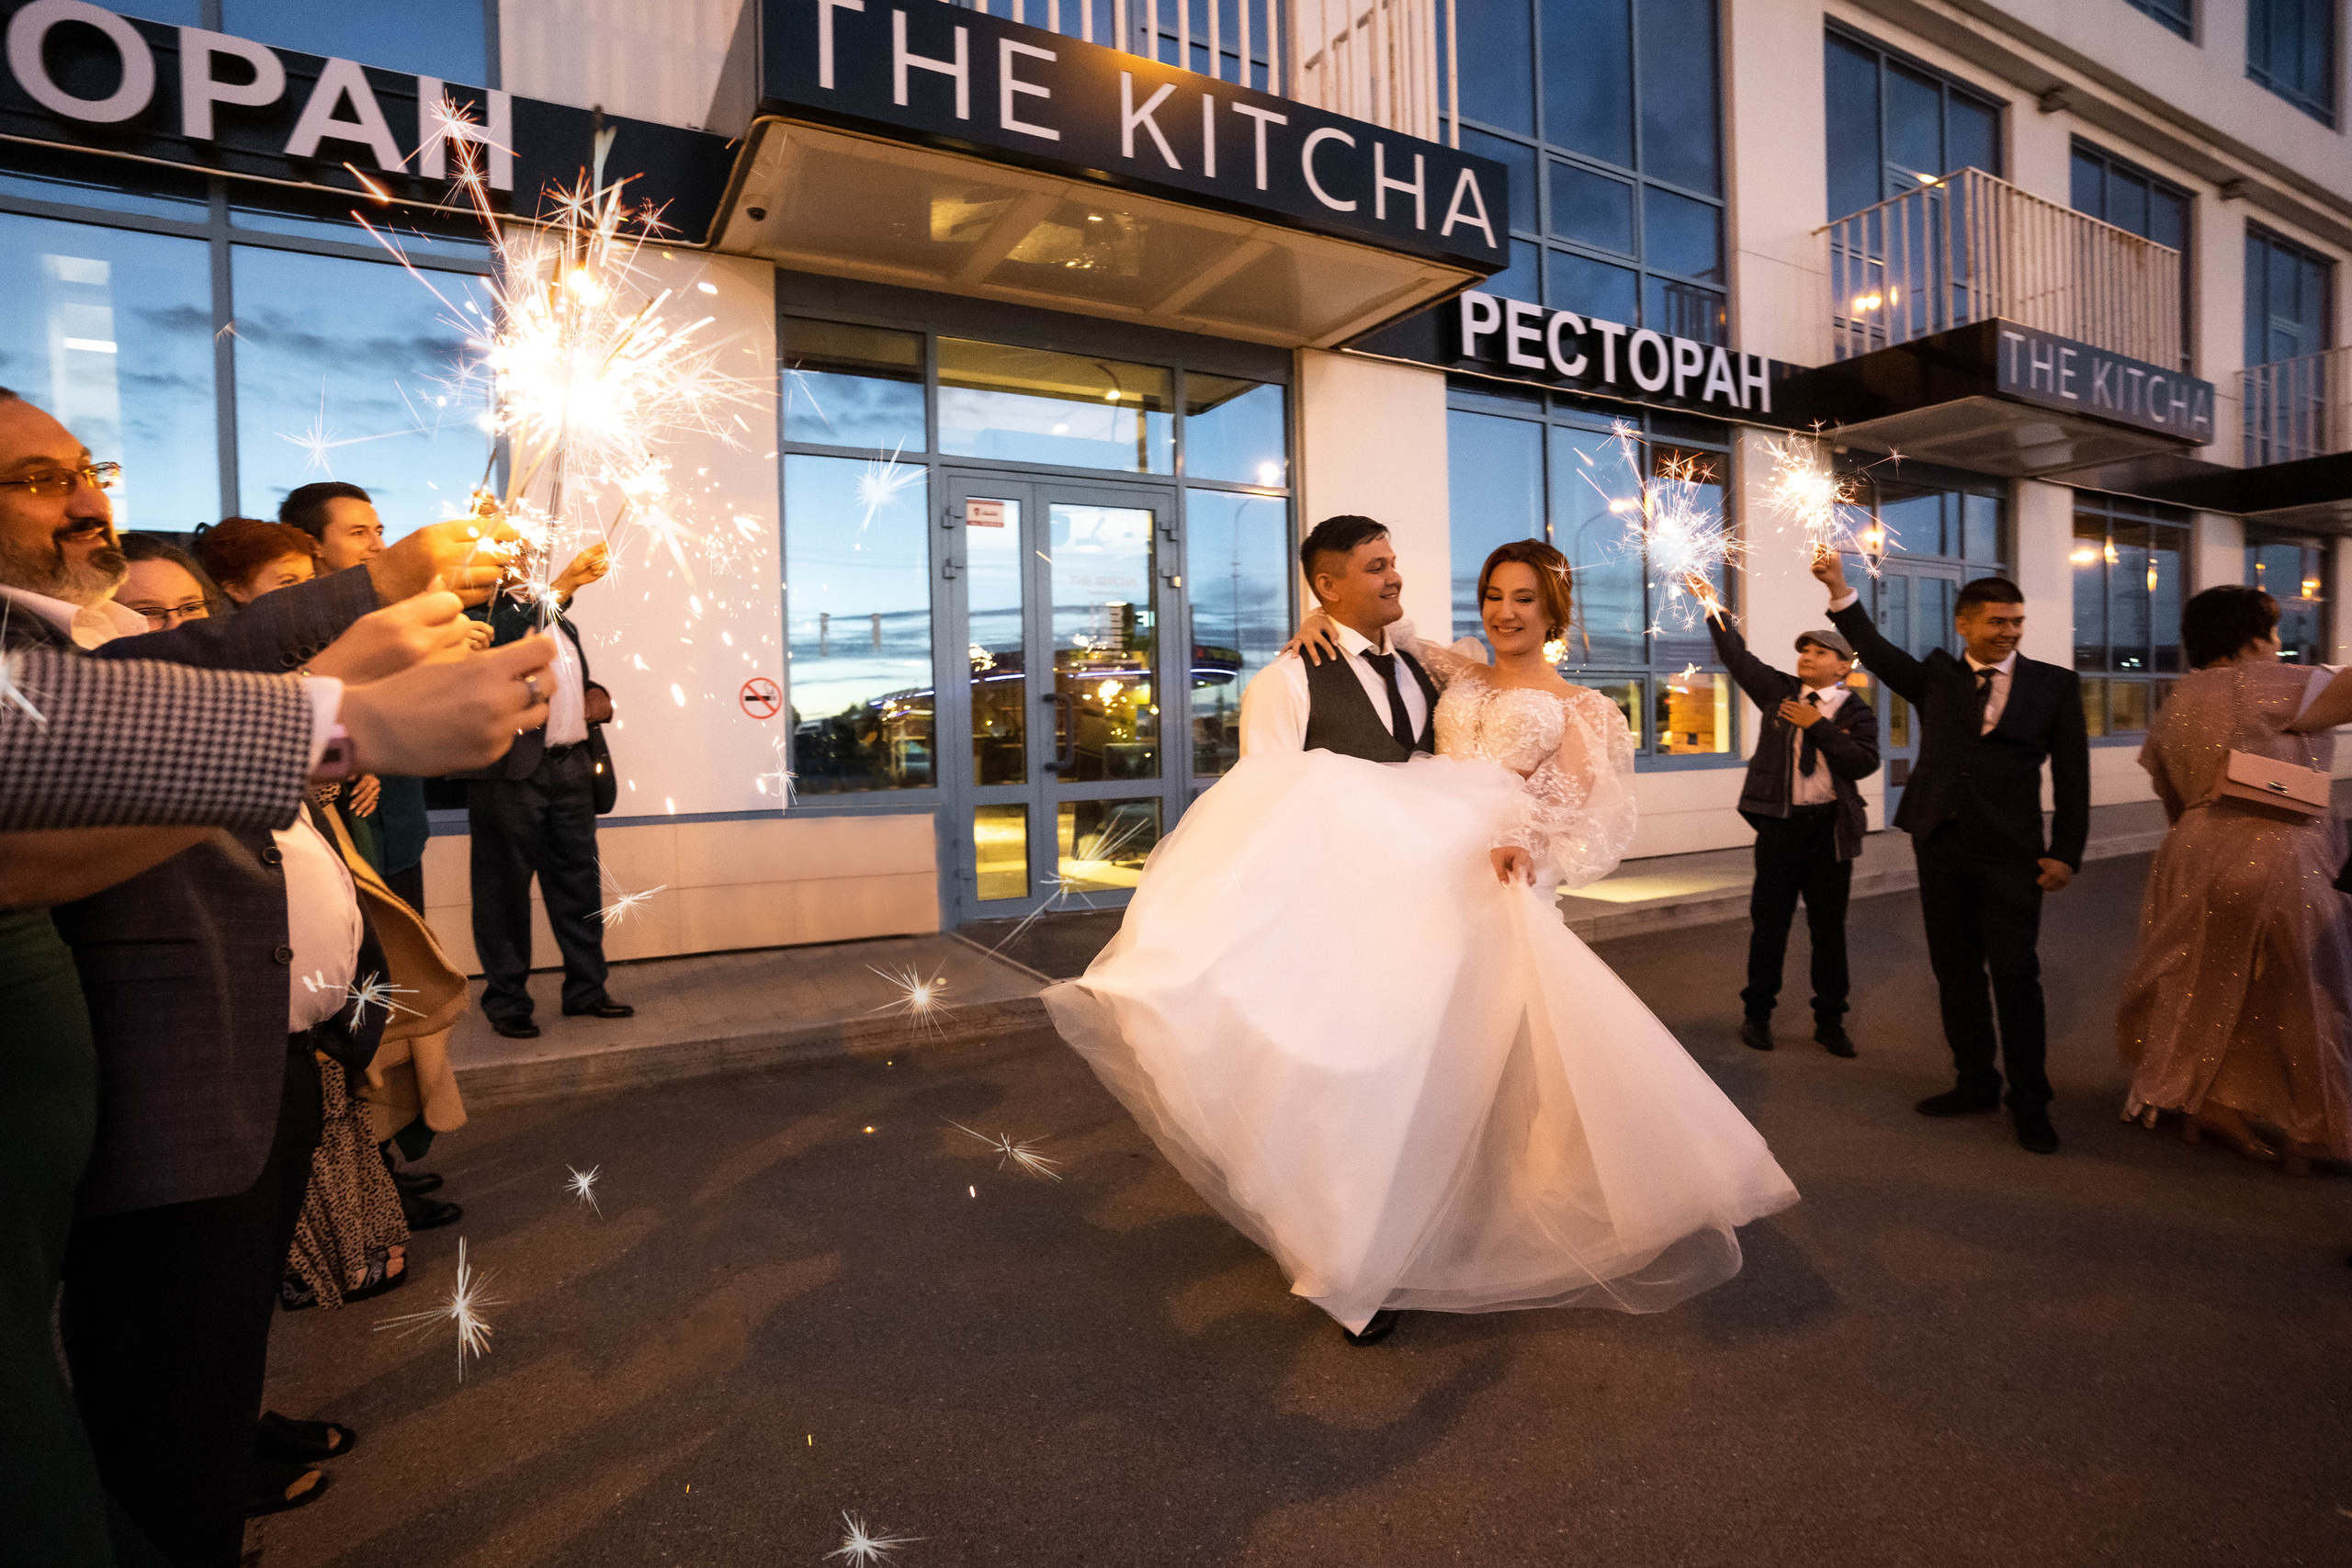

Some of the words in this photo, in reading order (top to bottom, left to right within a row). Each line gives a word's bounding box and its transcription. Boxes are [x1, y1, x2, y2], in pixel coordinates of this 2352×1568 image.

[818, 0, 1060, 141] THE
[1120, 70, 1498, 249] KITCHA
[1460, 289, 1771, 413] РЕСТОРАН
[2004, 330, 2078, 400] THE
[2093, 356, 2211, 430] KITCHA
